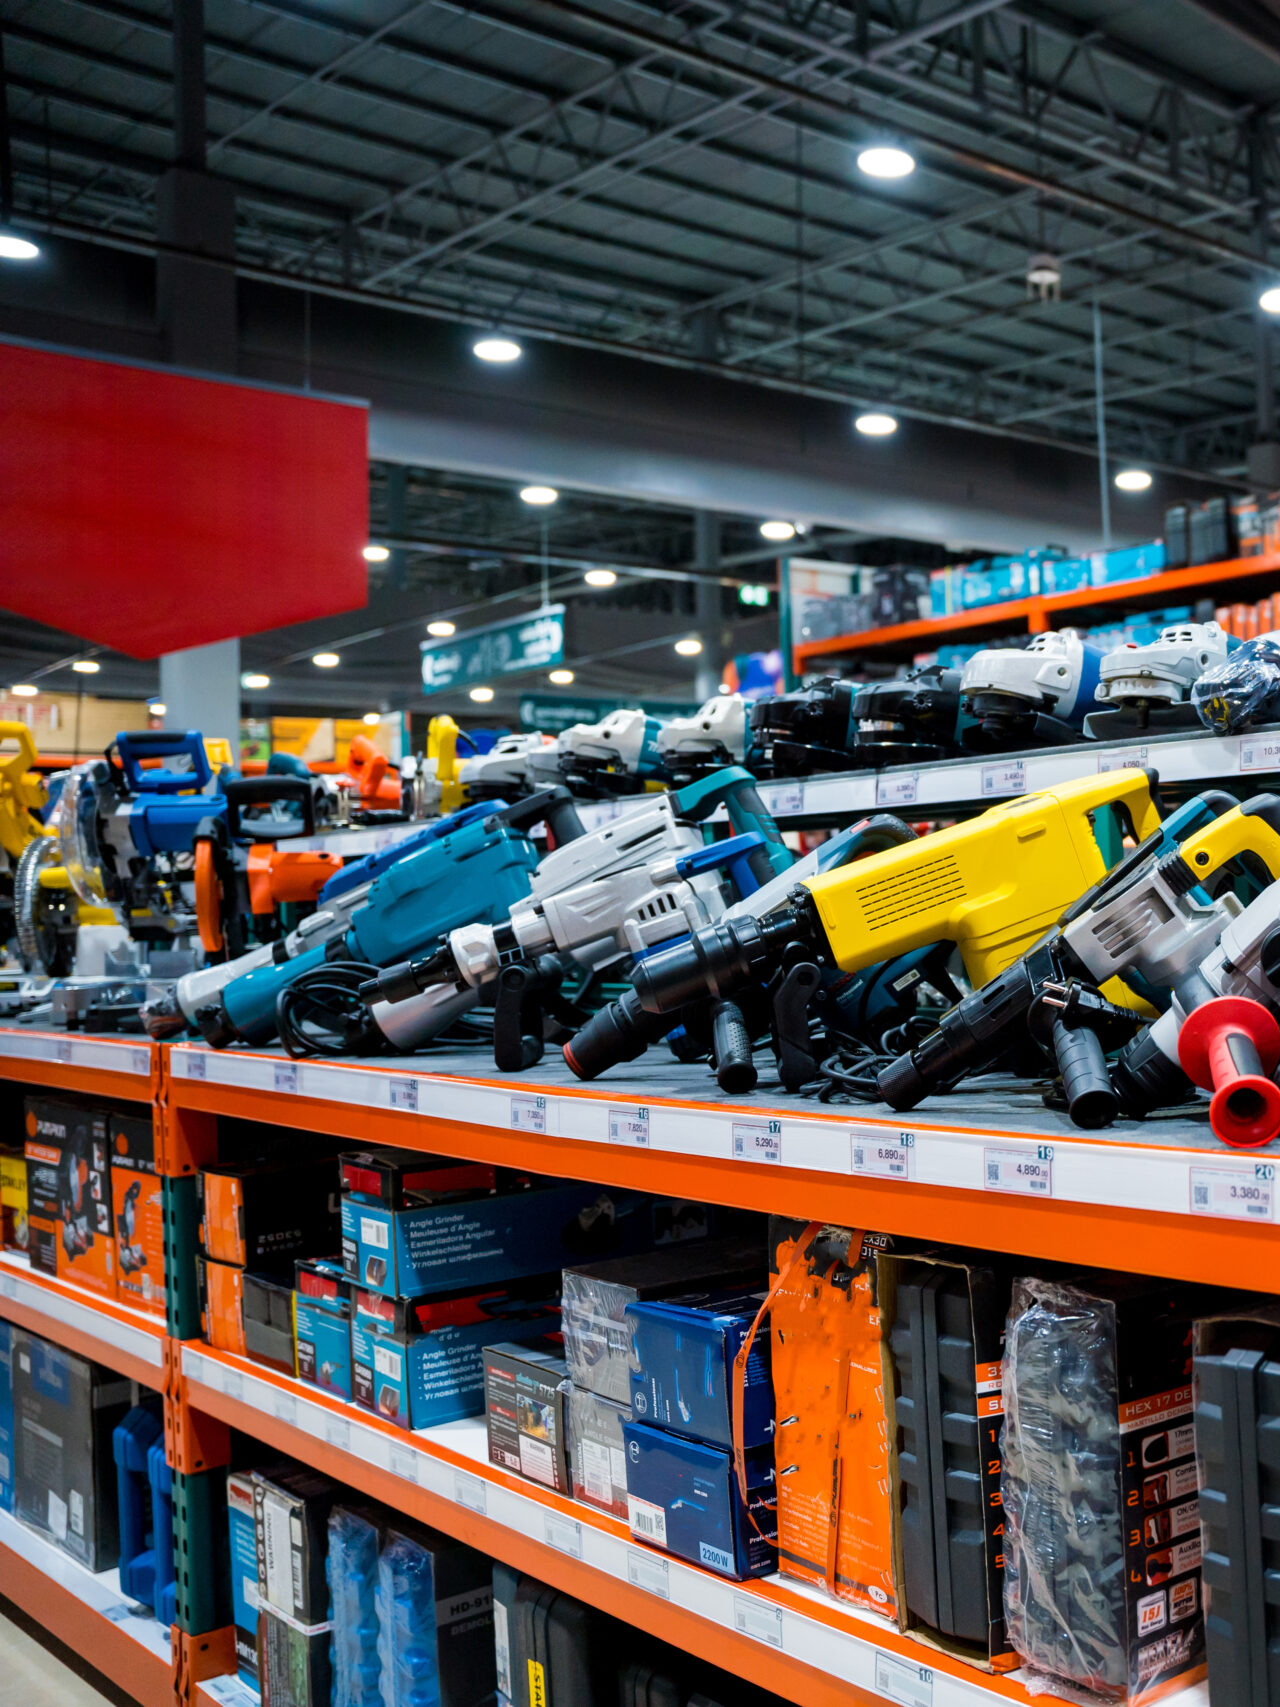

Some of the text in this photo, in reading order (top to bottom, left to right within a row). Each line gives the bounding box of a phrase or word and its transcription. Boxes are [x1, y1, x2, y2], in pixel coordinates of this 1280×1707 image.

[639, 1109, 648, 1119] 16
[770, 1121, 780, 1133] 17
[901, 1134, 914, 1147] 18
[1039, 1147, 1053, 1160] 19
[1256, 1165, 1274, 1180] 20
[409, 1213, 465, 1229] Angle Grinder
[410, 1226, 448, 1239] Meuleuse
[462, 1228, 495, 1241] Angular
[411, 1243, 472, 1258] Winkelschleifer
[422, 1343, 477, 1361] Angle Grinder
[423, 1358, 461, 1370] Meuleuse
[424, 1388, 459, 1400] Угловая
[1125, 1400, 1152, 1417] HEX
[1157, 1394, 1171, 1408] 17
[988, 1429, 996, 1443] 1
[1126, 1451, 1137, 1468] 1
[988, 1460, 1001, 1475] 2
[989, 1492, 1003, 1507] 3
[1127, 1490, 1139, 1507] 2
[992, 1523, 1005, 1537] 4
[266, 1513, 275, 1570] WARNING
[1129, 1529, 1141, 1547] 3
[995, 1554, 1006, 1569] 5
[1130, 1569, 1143, 1583] 4
[920, 1669, 933, 1684] 10
